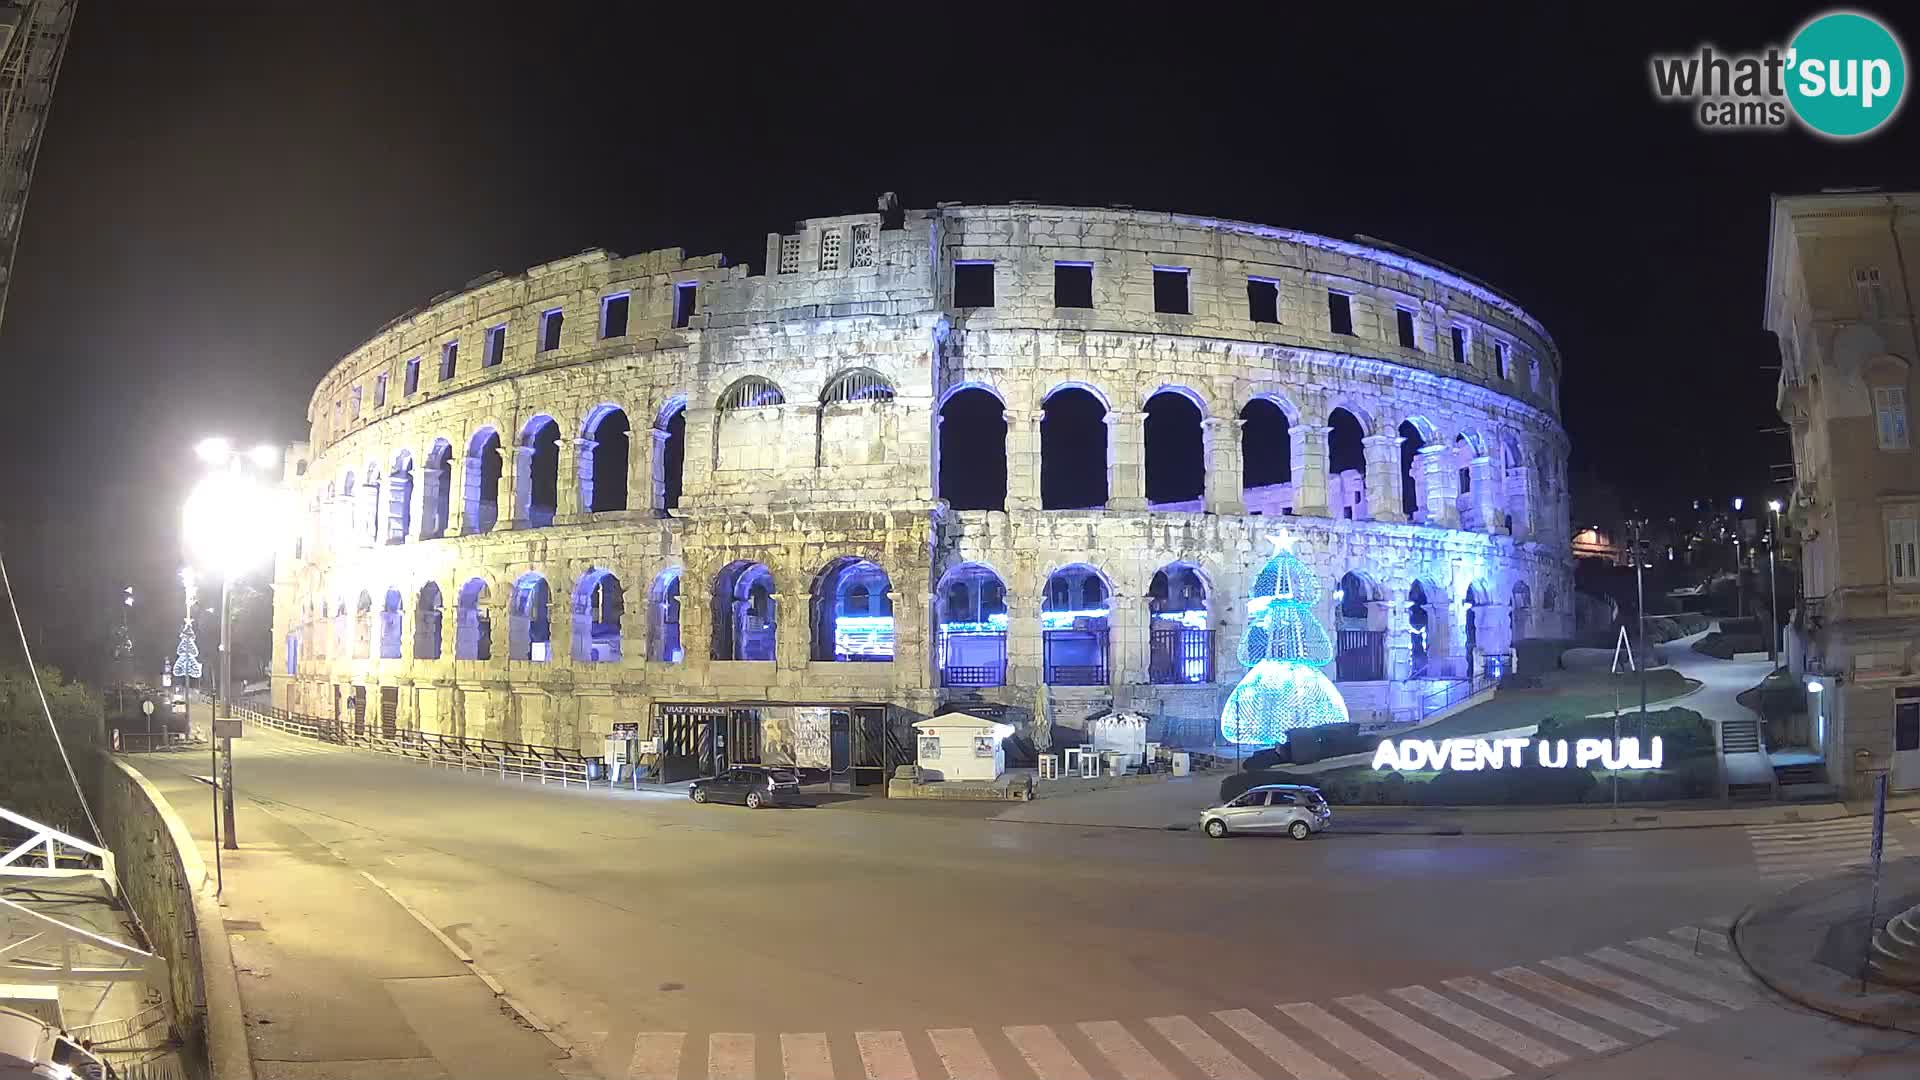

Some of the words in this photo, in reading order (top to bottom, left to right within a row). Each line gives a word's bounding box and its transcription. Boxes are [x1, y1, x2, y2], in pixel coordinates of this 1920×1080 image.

[666, 705, 683, 713] ULAZ
[689, 706, 725, 715] ENTRANCE
[1371, 737, 1530, 771] ADVENT
[1538, 738, 1568, 769] U
[1576, 736, 1663, 770] PULI
